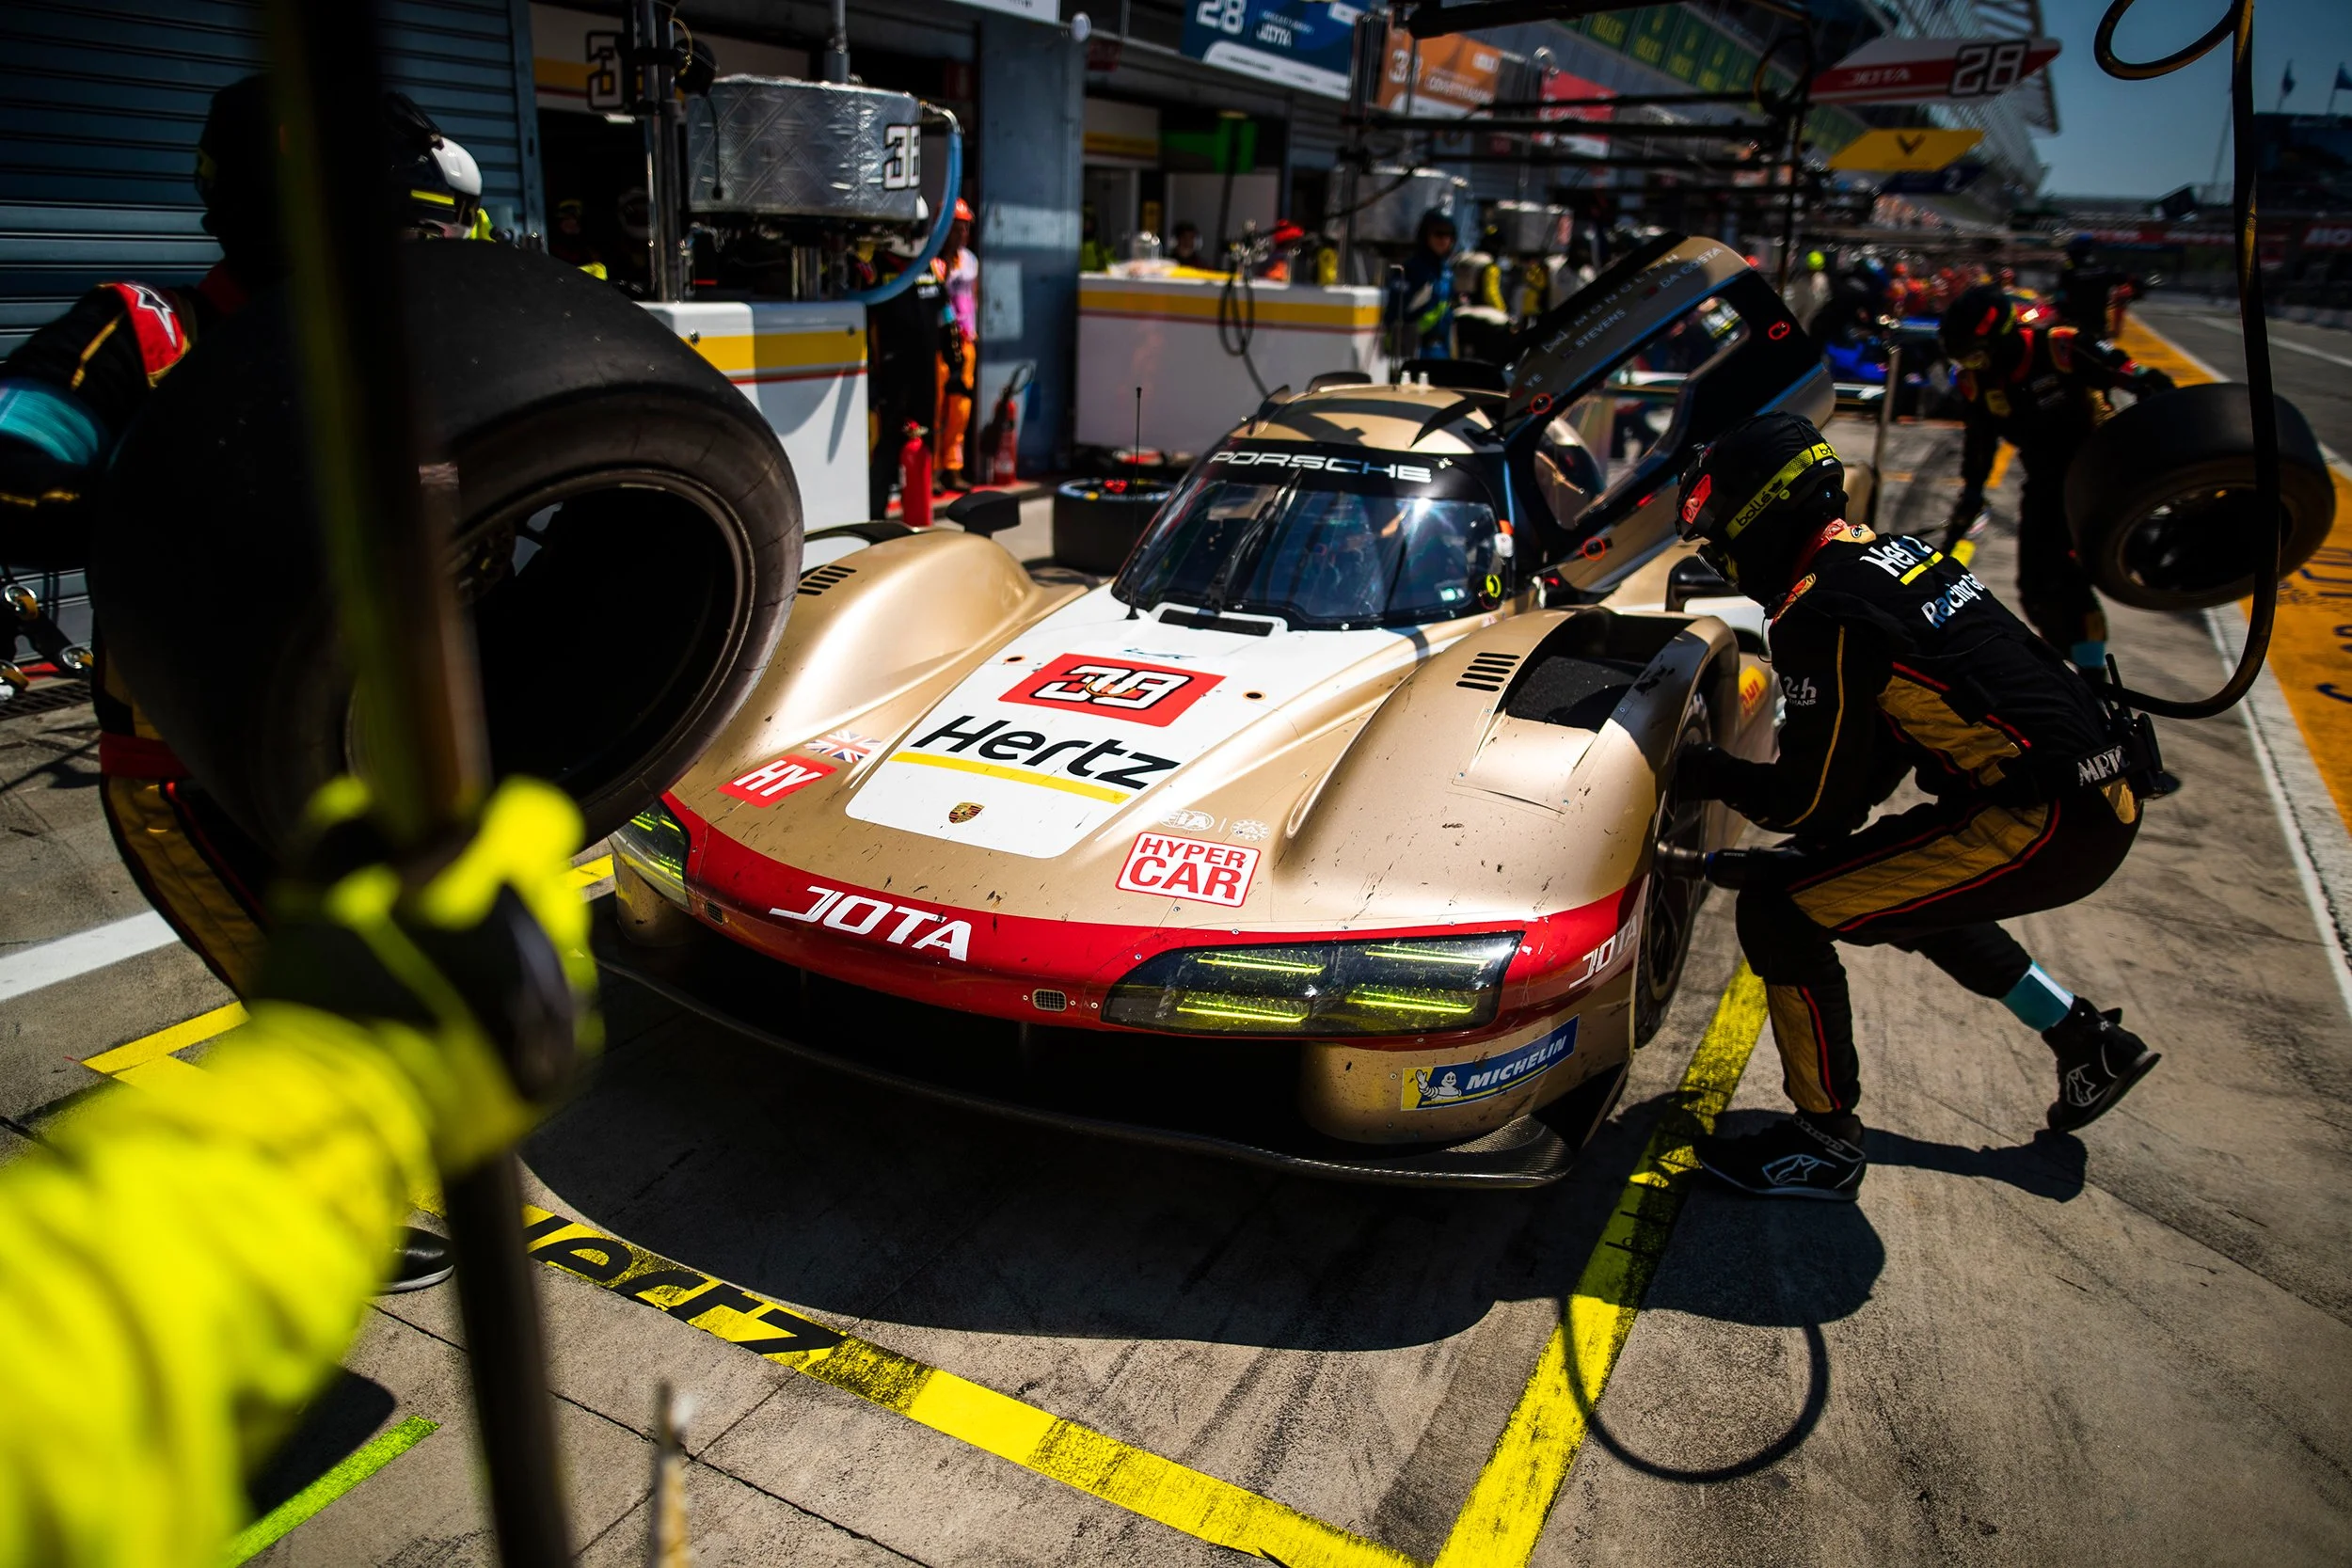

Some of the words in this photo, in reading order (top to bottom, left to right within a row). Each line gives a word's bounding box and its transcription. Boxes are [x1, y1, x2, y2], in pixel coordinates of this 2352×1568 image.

[1950, 40, 2029, 98] 28
[1575, 306, 1628, 350] STEVENS
[1208, 451, 1433, 483] PORSCHE
[1735, 489, 1772, 527] bollé
[1029, 663, 1195, 711] 38
[909, 715, 1182, 790] Hertz
[732, 759, 823, 797] HY
[1139, 837, 1247, 868] HYPER
[1129, 856, 1242, 900] CAR
[768, 885, 972, 961] JOTA
[1568, 914, 1637, 989] JOTA
[1465, 1035, 1567, 1091] MICHELIN
